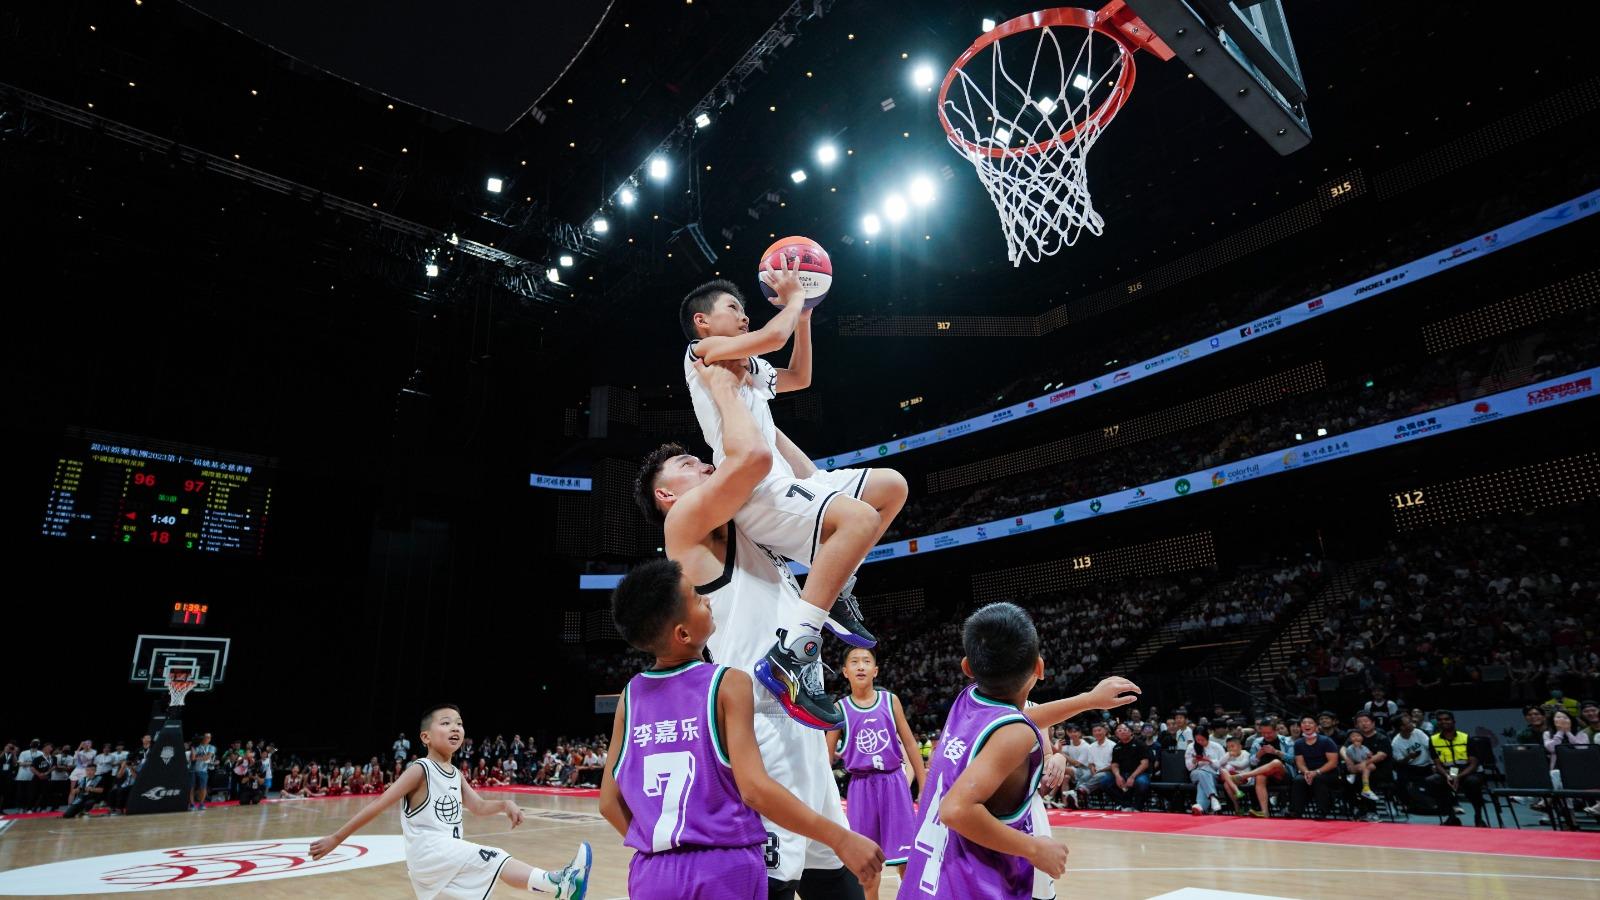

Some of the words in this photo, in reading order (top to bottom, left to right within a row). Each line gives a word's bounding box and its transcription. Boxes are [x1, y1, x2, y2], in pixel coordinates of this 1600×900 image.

[1329, 180, 1352, 198] 315
[1126, 280, 1143, 294] 316
[936, 320, 951, 331] 317
[1103, 424, 1120, 438] 217
[133, 471, 157, 487] 96
[183, 478, 205, 494] 97
[784, 483, 816, 502] 7
[1394, 490, 1425, 509] 112
[150, 514, 176, 526] 1:40
[123, 533, 131, 542] 2
[150, 529, 171, 545] 18
[186, 540, 193, 549] 3
[1072, 556, 1092, 570] 113
[183, 611, 201, 624] 17
[632, 716, 700, 747] 李嘉乐
[871, 754, 886, 771] 6
[641, 749, 698, 853] 7
[914, 772, 950, 897] 4
[478, 847, 497, 863] 4
[765, 831, 781, 870] 3
